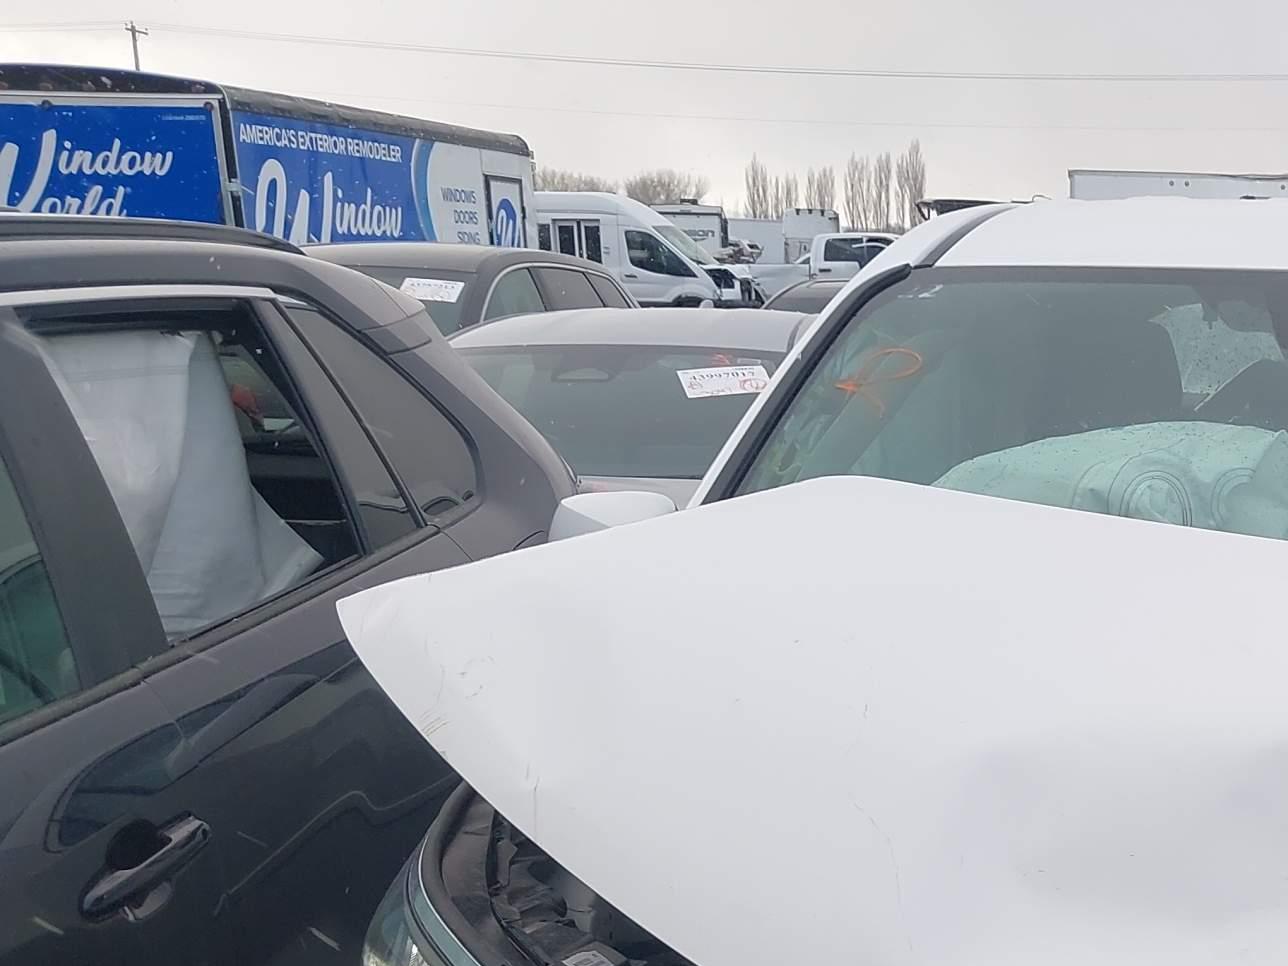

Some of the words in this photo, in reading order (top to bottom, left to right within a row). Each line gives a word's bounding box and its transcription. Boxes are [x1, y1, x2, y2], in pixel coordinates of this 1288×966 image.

[239, 122, 297, 149] AMERICA'S
[298, 131, 347, 156] EXTERIOR
[347, 138, 402, 163] REMODELER
[440, 186, 477, 204] WINDOWS
[453, 209, 479, 225] DOORS
